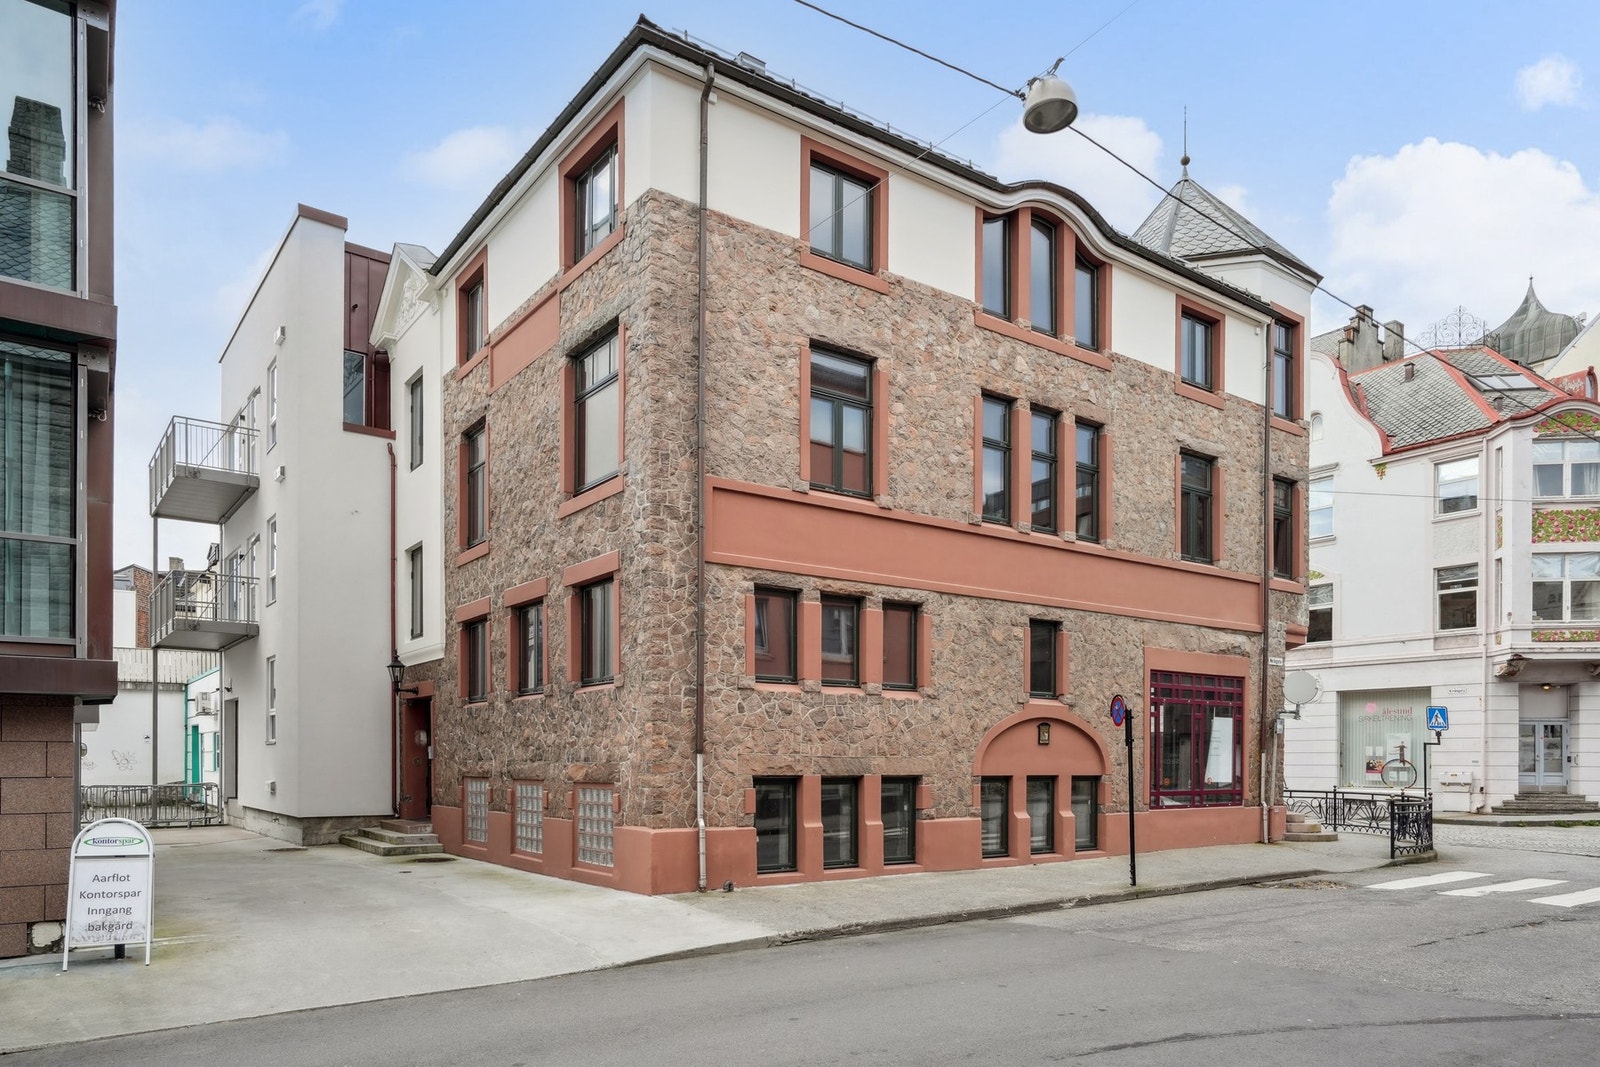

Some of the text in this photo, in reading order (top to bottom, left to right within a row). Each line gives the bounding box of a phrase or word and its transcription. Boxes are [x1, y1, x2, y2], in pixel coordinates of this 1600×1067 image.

[92, 873, 131, 882] Aarflot
[79, 890, 142, 899] Kontorspar
[87, 906, 132, 916] Inngang
